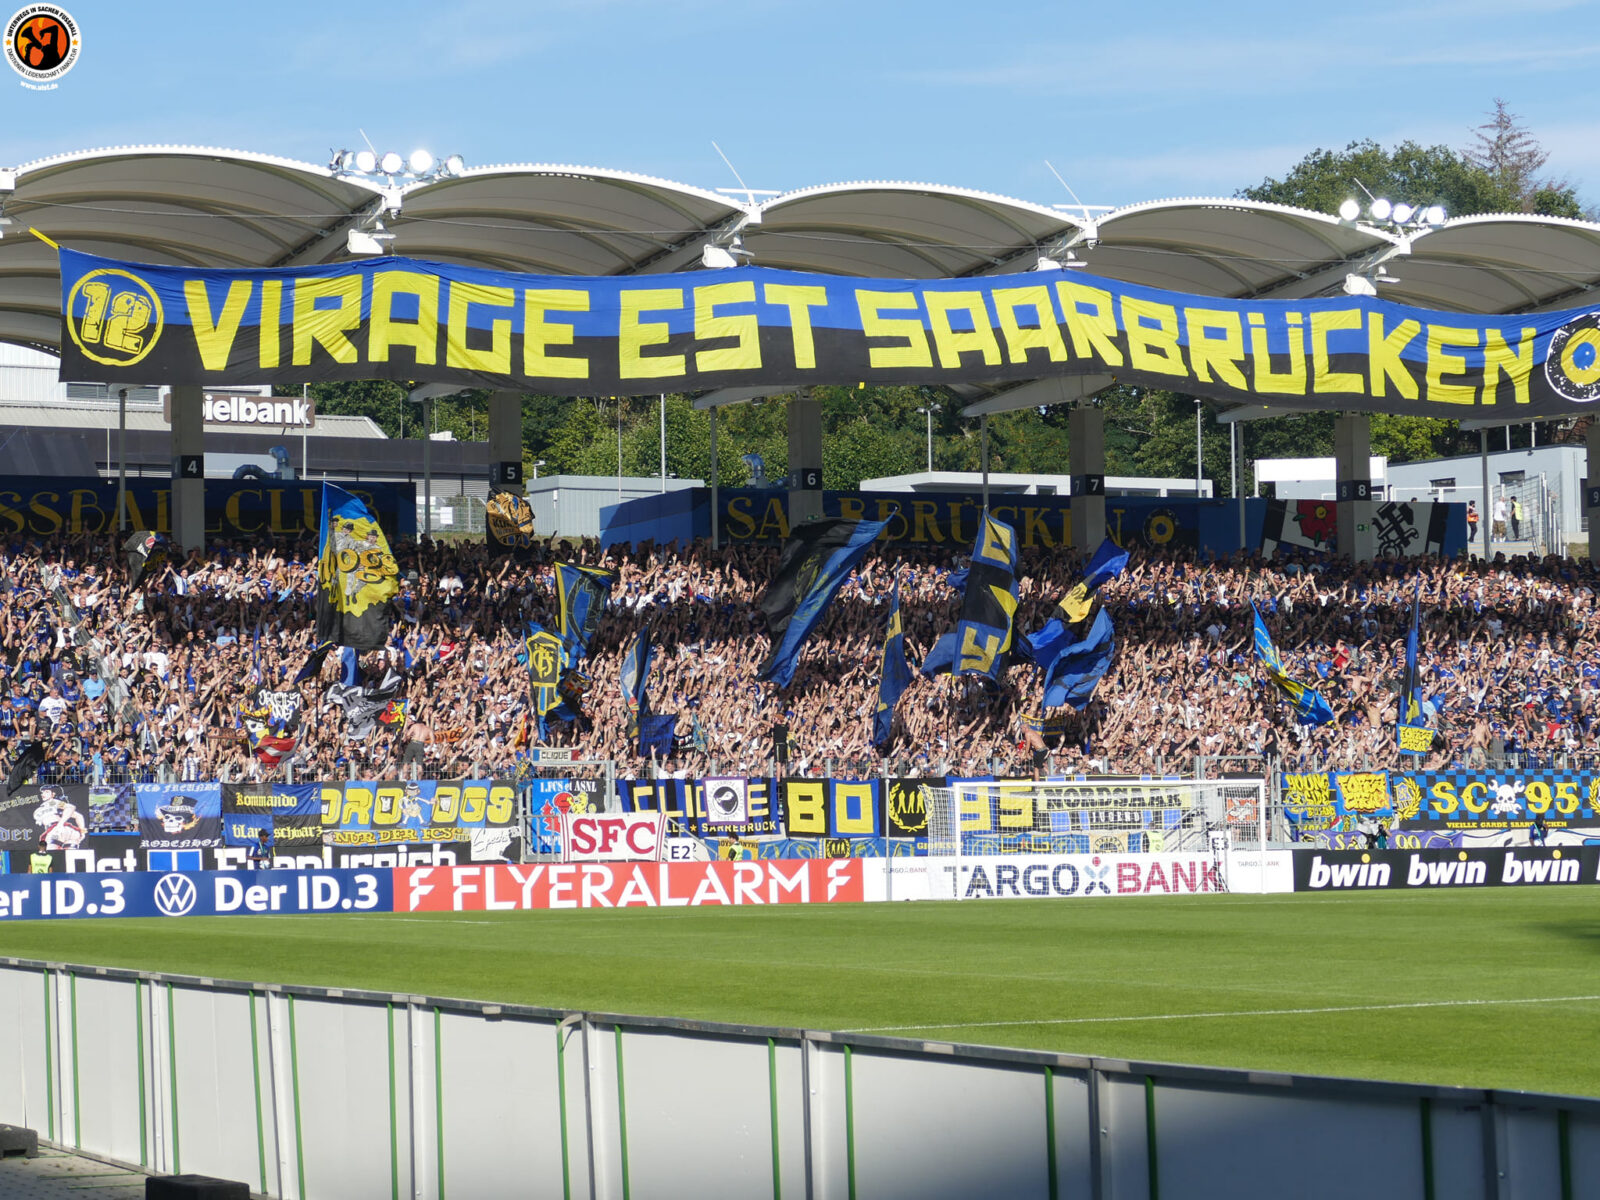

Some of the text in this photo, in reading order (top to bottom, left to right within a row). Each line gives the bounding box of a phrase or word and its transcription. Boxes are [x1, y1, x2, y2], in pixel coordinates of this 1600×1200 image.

[82, 282, 151, 354] 12
[184, 271, 1537, 404] VIRAGE EST SAARBRÜCKEN
[203, 397, 311, 425] ielbank
[187, 460, 198, 473] 4
[507, 467, 515, 479] 5
[807, 473, 816, 486] 6
[1091, 479, 1099, 491] 7
[1358, 484, 1366, 496] 8
[1593, 491, 1599, 503] 9
[541, 751, 569, 760] CLIQUE
[164, 783, 221, 793] FREUNDE
[1285, 773, 1329, 791] YOUNG
[1430, 781, 1580, 814] SC 95
[139, 839, 221, 849] RODENHOF
[334, 827, 452, 844] NUR DER FCS
[571, 818, 656, 855] SFC
[671, 845, 691, 860] E2
[1309, 854, 1391, 887] bwin
[1407, 851, 1487, 886] bwin
[1502, 849, 1580, 884] bwin
[215, 873, 379, 912] Der ID.3
[452, 860, 810, 911] FLYERALARM
[41, 878, 126, 916] ID.3
